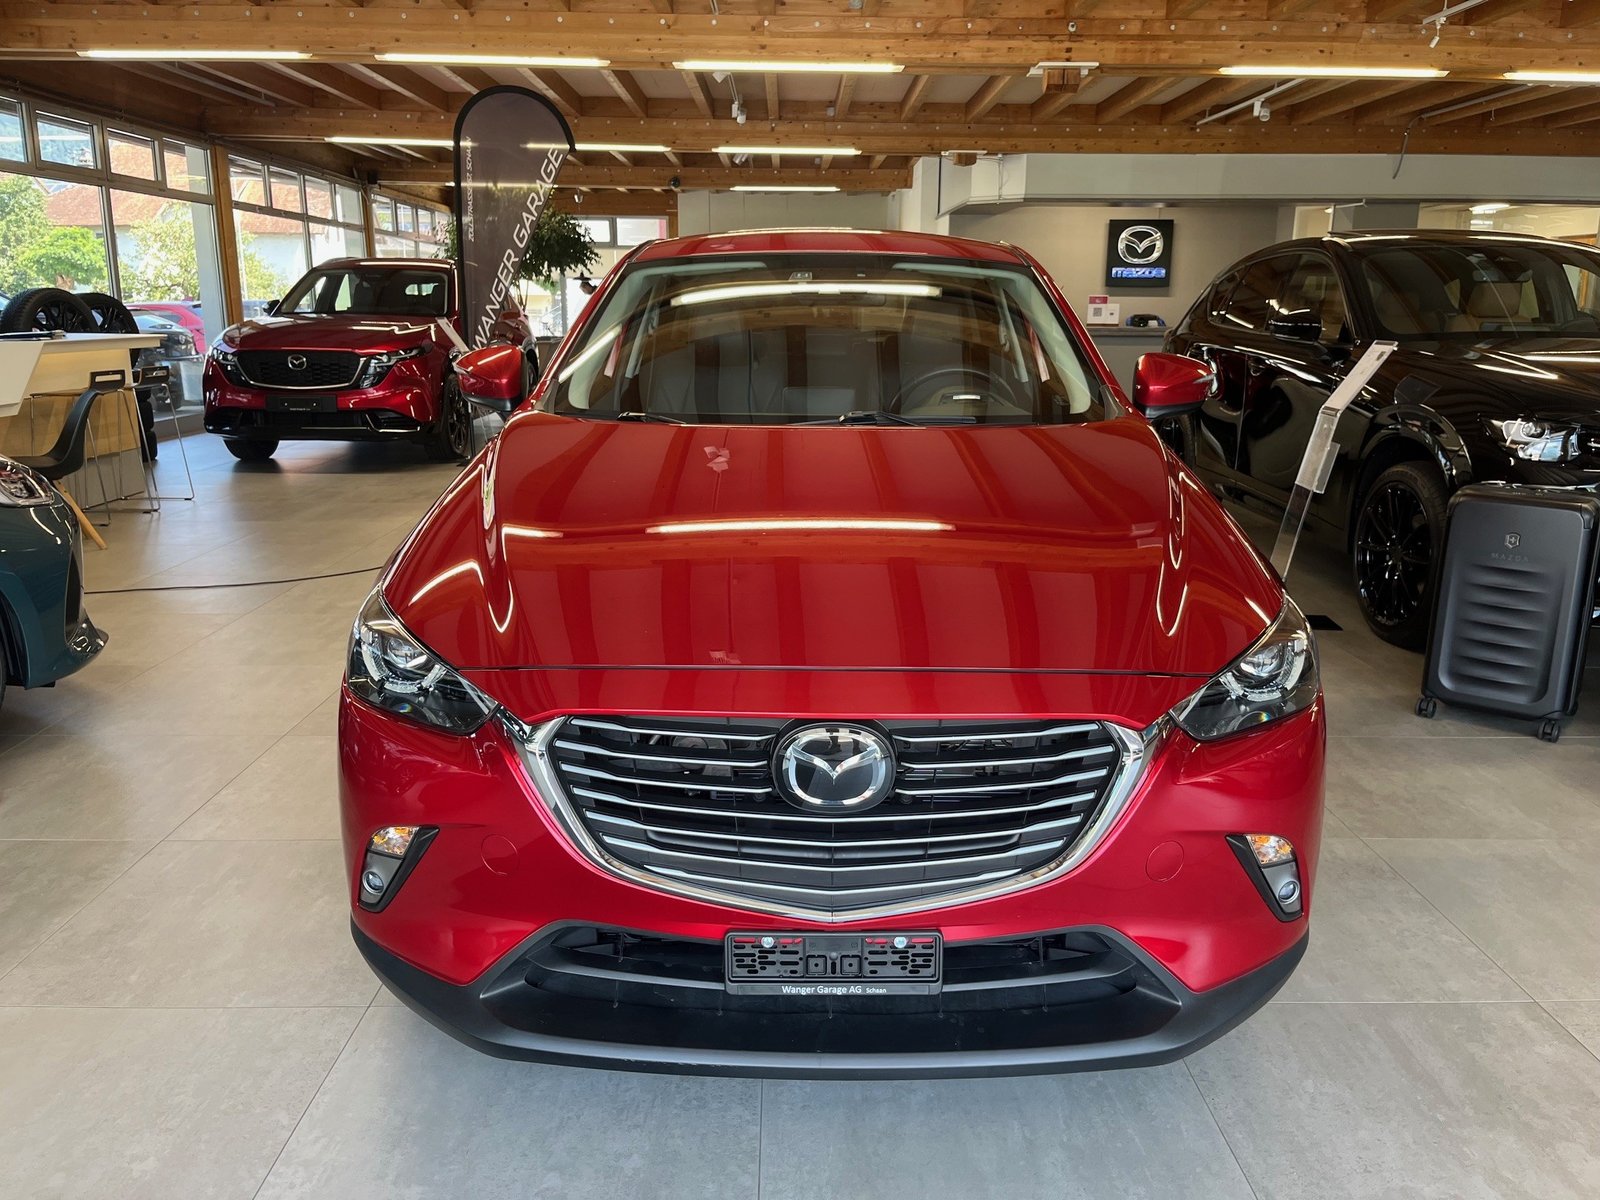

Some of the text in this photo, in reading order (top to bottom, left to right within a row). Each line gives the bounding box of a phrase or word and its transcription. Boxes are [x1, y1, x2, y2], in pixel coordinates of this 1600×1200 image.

[472, 144, 563, 350] WANGER GARAGE
[781, 985, 815, 995] Wanger
[816, 985, 848, 995] Garage
[848, 985, 862, 994] AG
